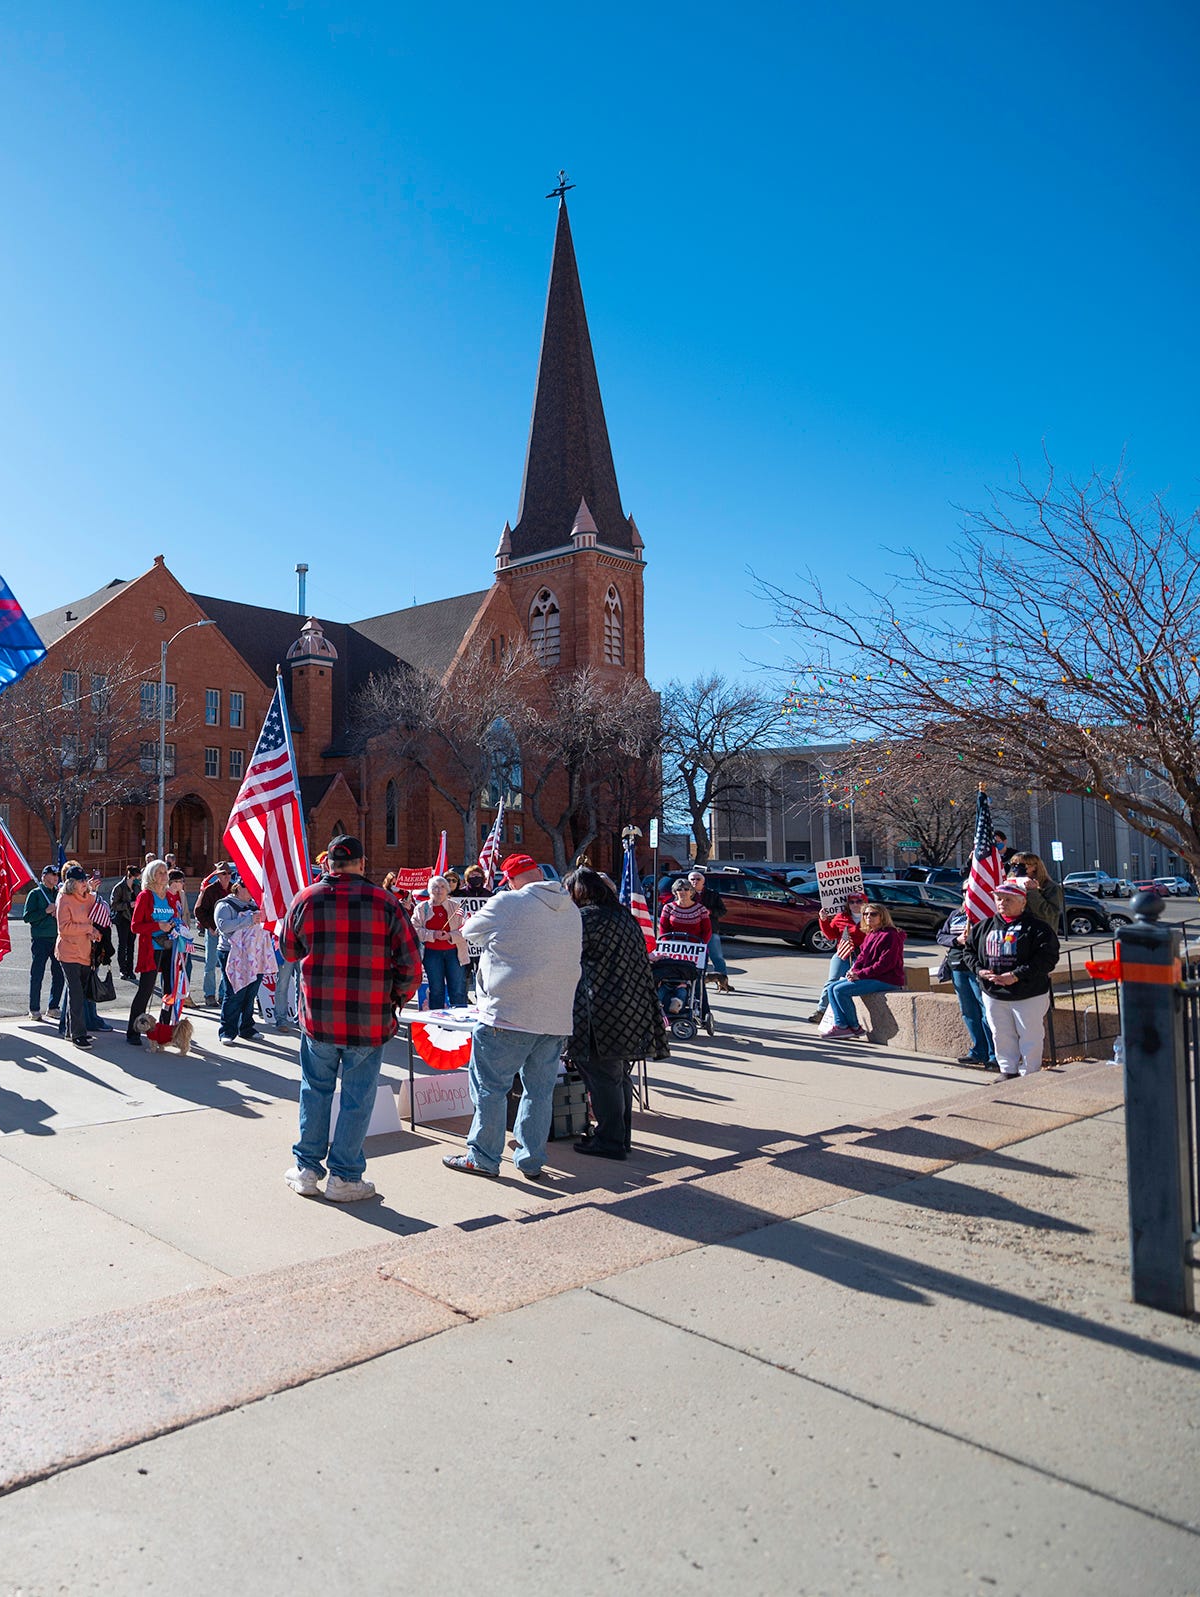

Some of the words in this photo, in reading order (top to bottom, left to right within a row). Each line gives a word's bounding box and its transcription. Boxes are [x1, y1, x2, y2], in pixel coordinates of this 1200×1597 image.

[827, 859, 849, 869] BAN
[818, 866, 860, 879] DOMINION
[820, 875, 861, 887] VOTING
[821, 885, 863, 897] MACHINES
[832, 896, 848, 905] AN
[656, 942, 705, 955] TRUMP
